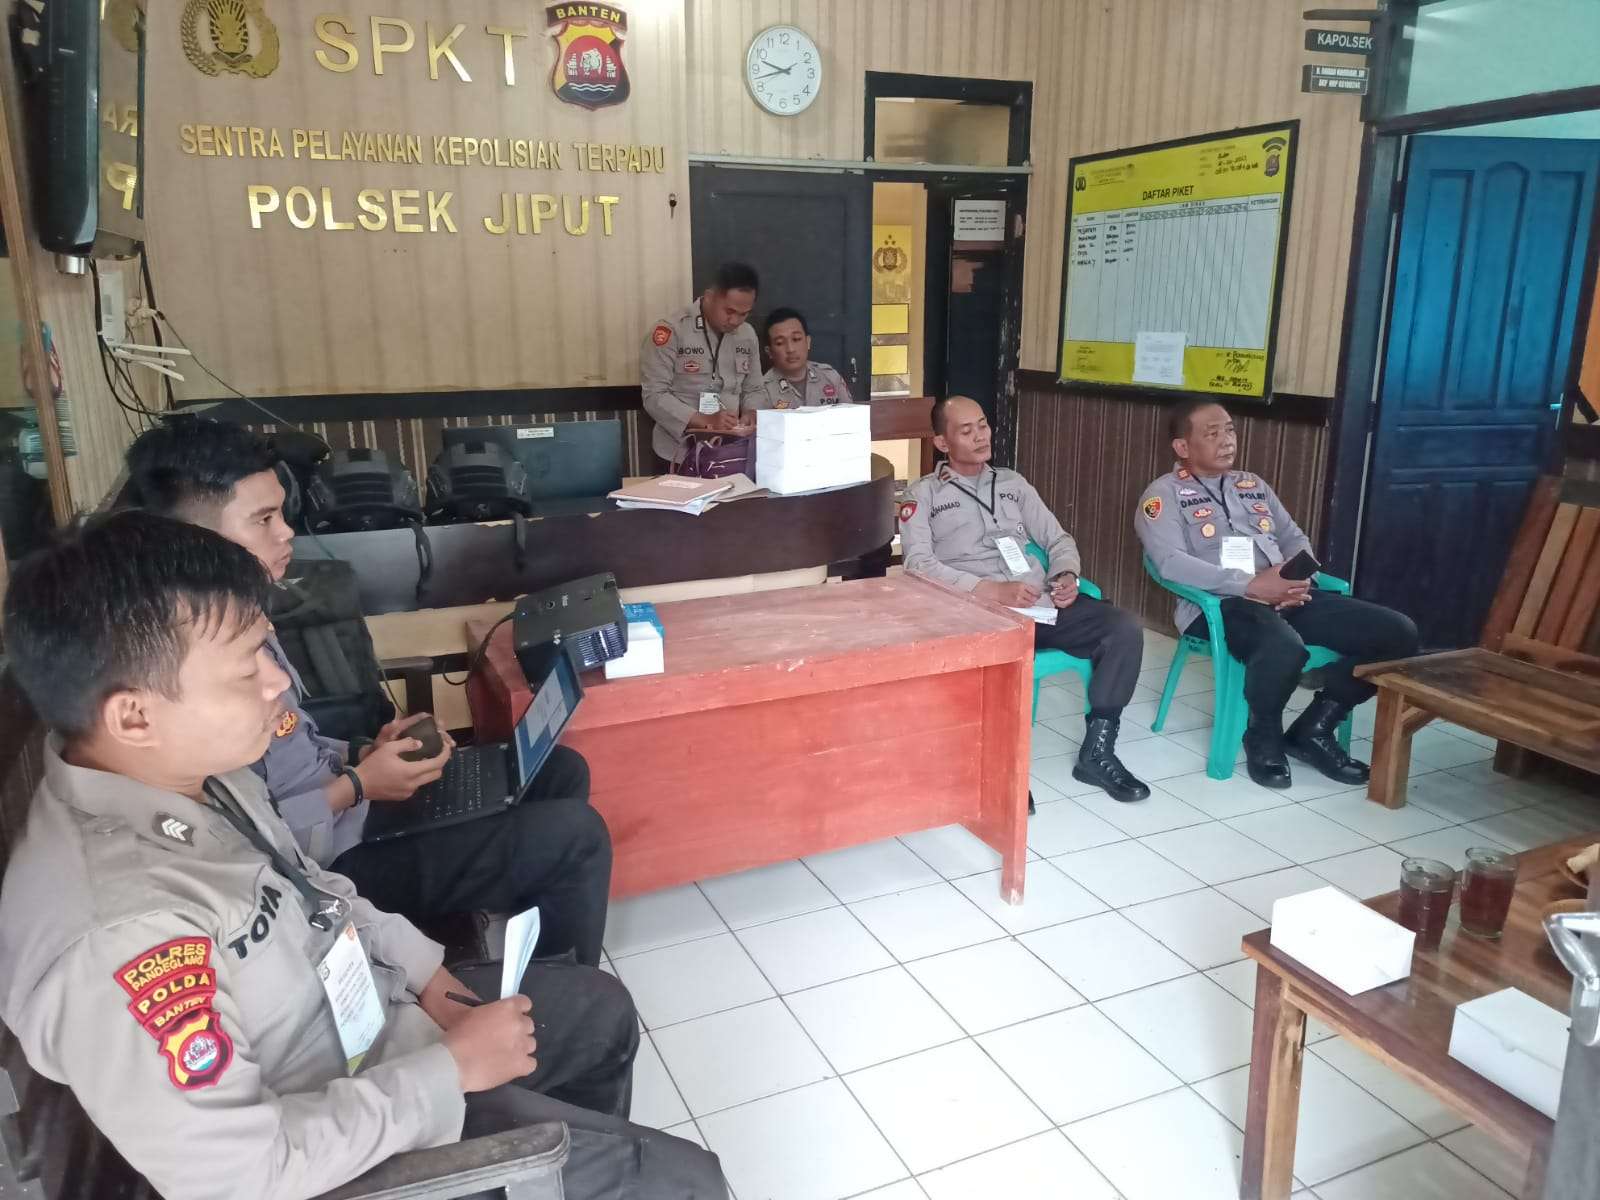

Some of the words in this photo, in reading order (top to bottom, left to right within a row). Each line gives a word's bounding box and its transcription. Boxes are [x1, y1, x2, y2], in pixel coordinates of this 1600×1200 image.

[556, 6, 621, 23] BANTEN
[766, 37, 774, 48] 11
[779, 32, 790, 45] 12
[1317, 32, 1374, 50] KAPOLSEK
[756, 48, 768, 60] 10
[803, 51, 812, 64] 2
[752, 64, 760, 74] 9
[807, 68, 815, 79] 3
[802, 84, 811, 96] 4
[766, 93, 773, 102] 7
[779, 98, 787, 109] 6
[793, 94, 800, 105] 5
[179, 124, 285, 158] SENTRA
[291, 129, 424, 164] PELAYANAN
[433, 135, 562, 170] KEPOLISIAN
[573, 142, 664, 173] TERPADU
[1142, 188, 1170, 201] DAFTAR
[1172, 185, 1194, 197] PIKET
[248, 185, 458, 233] POLSEK
[484, 192, 621, 236] JIPUT
[1238, 492, 1266, 500] POLRI
[228, 885, 283, 960] TOYA
[123, 943, 206, 985] POLRES
[131, 955, 204, 992] PANDEGLANG
[137, 972, 210, 1014] POLDA
[154, 996, 206, 1027] BANTEN
